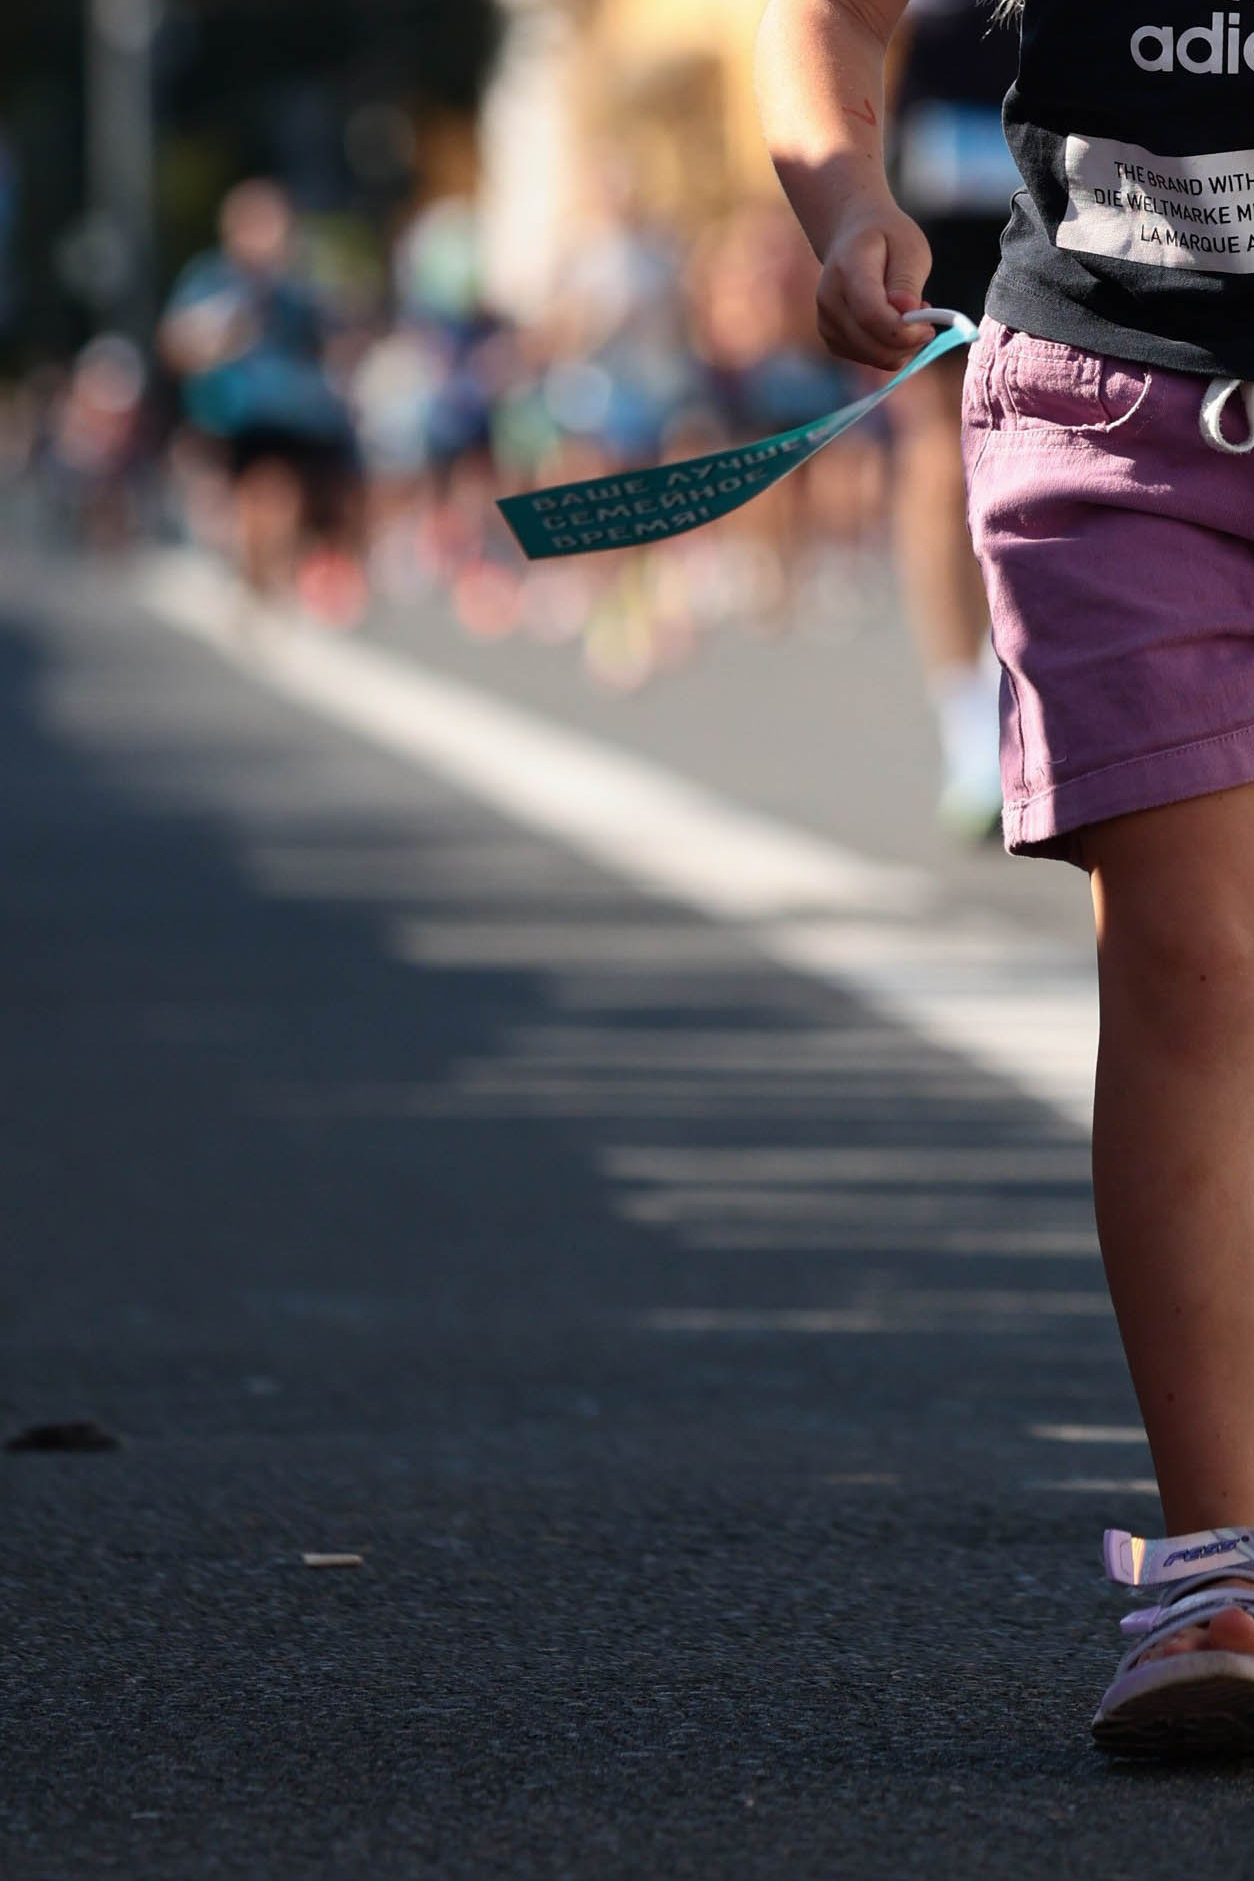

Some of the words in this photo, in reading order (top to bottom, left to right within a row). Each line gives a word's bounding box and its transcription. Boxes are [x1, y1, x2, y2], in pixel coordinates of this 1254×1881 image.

[1114, 161, 1146, 184] THE
[1147, 170, 1203, 196] BRAND
[1094, 188, 1124, 208] DIE
[1126, 193, 1232, 226] WELTMARKE
[1140, 224, 1163, 245] LA
[1165, 229, 1241, 254] MARQUE
